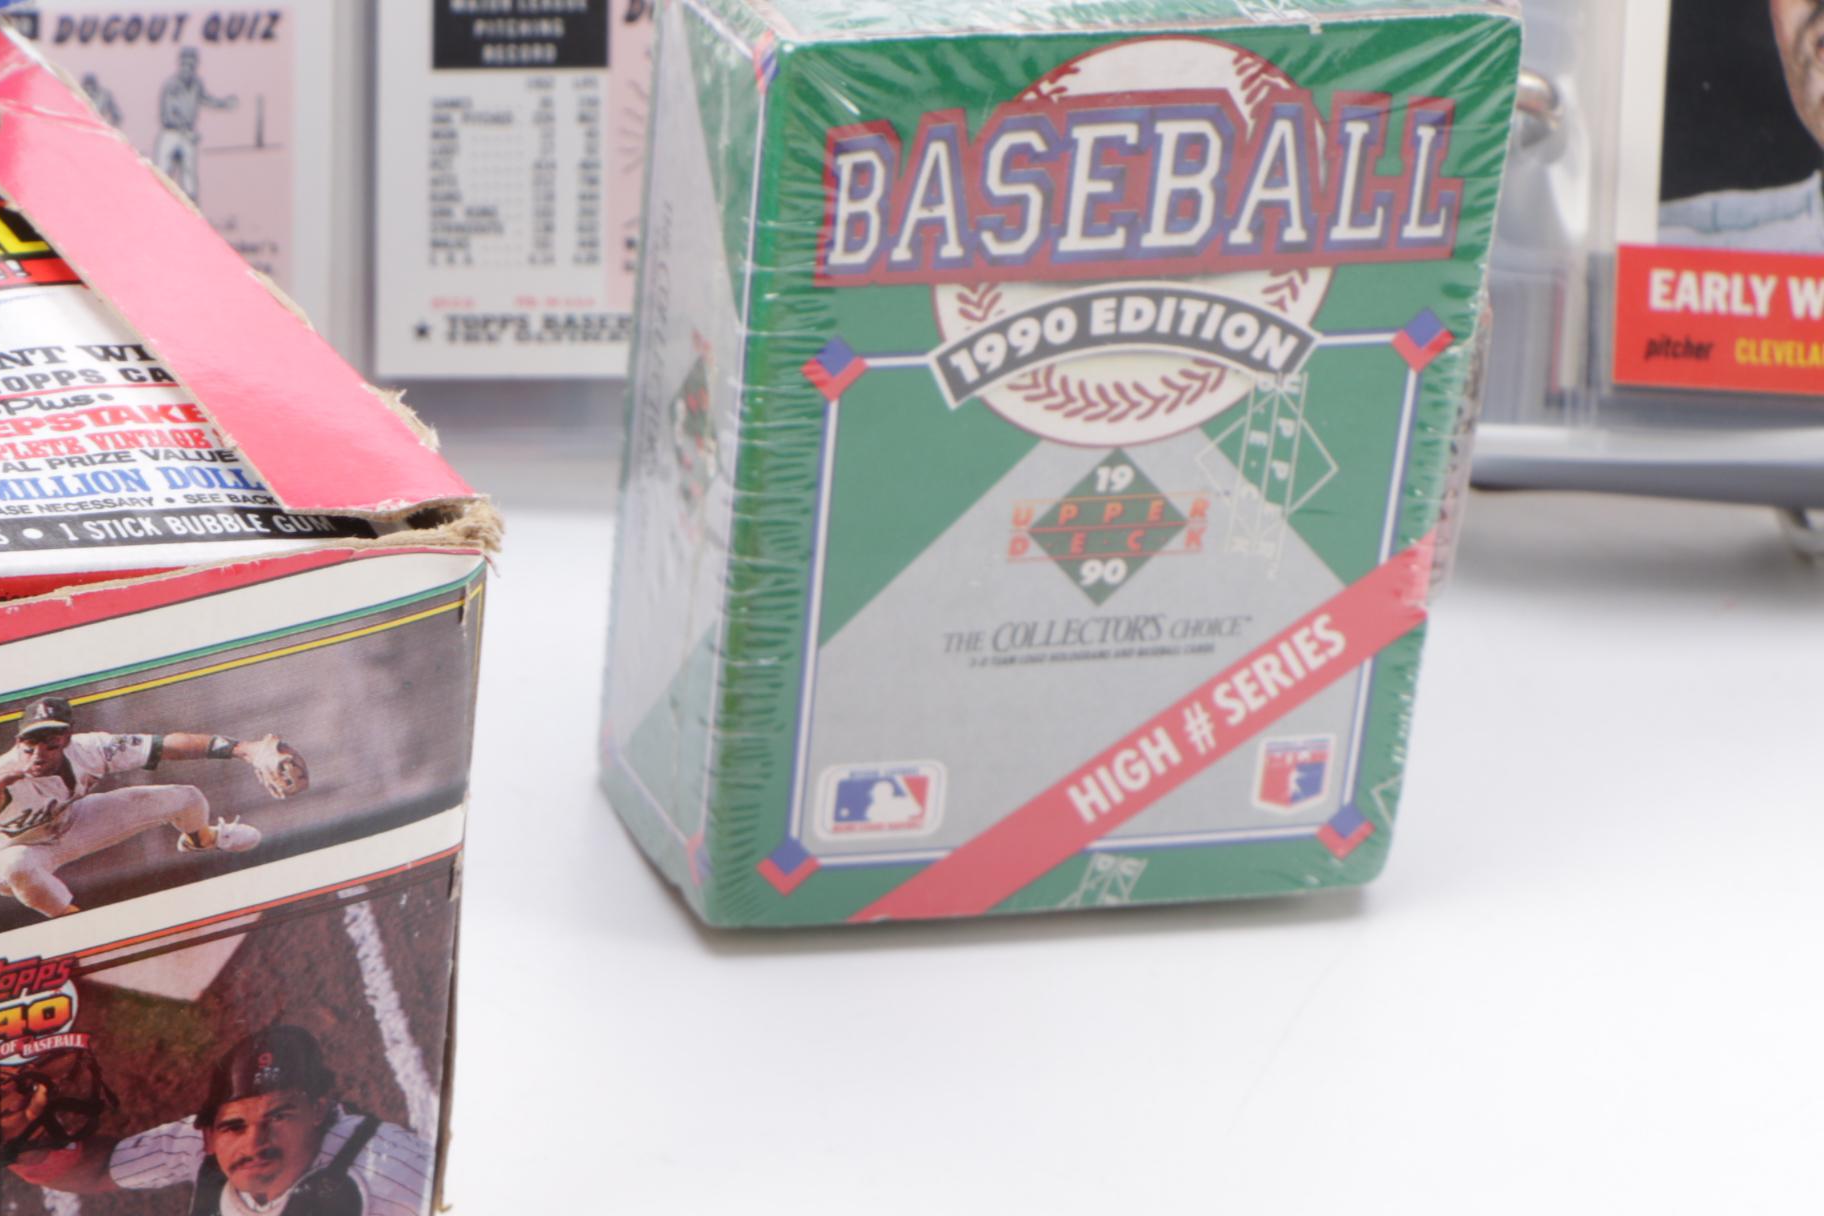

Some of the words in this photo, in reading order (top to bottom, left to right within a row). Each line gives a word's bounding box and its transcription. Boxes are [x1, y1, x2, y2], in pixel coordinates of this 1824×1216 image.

[52, 12, 183, 45] DUGOUT
[201, 12, 283, 42] QUIZ
[482, 44, 557, 62] RECORD
[822, 105, 1457, 275] BASEBALL
[1647, 270, 1778, 316] EARLY
[949, 303, 1076, 384] 1990
[1088, 297, 1299, 371] EDITION
[1645, 337, 1713, 361] pitcher
[1735, 338, 1824, 366] CLEVELA
[1096, 466, 1134, 492] 19
[82, 517, 159, 542] STICK
[166, 513, 267, 535] BUBBLE
[272, 512, 334, 535] GUM
[1078, 559, 1127, 586] 90
[944, 632, 984, 653] THE
[1067, 730, 1181, 822] HIGH
[1184, 709, 1221, 753] #
[1210, 616, 1348, 728] SERIES
[22, 1034, 88, 1053] BASEBALL
